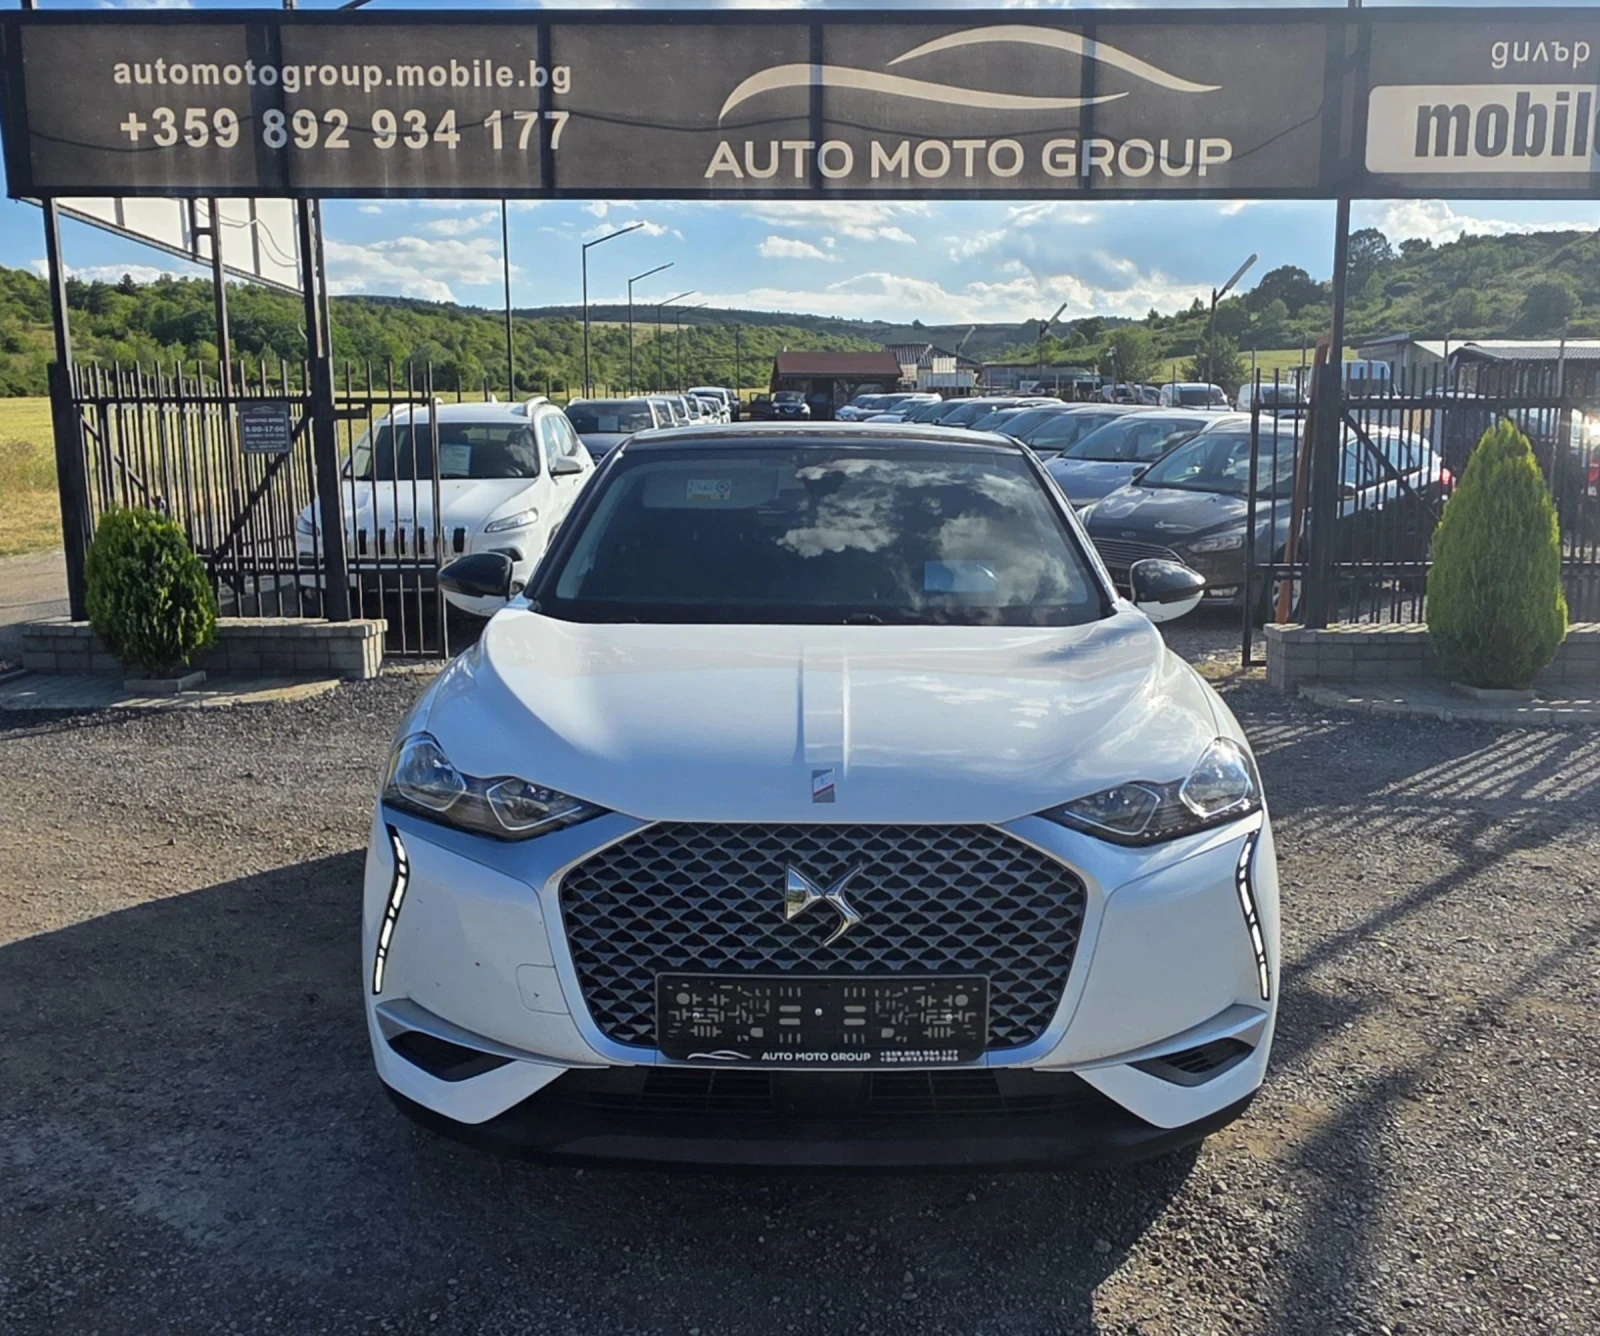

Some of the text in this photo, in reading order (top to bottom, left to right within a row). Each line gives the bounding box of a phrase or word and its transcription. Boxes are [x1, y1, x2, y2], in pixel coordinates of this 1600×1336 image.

[1491, 41, 1591, 69] дилър
[114, 58, 572, 94] automotogroup.mobile.bg
[120, 107, 570, 150] +359 892 934 177
[1414, 91, 1600, 158] mobil
[703, 138, 1233, 179] AUTO MOTO GROUP
[761, 1052, 872, 1062] AUTO MOTO GROUP
